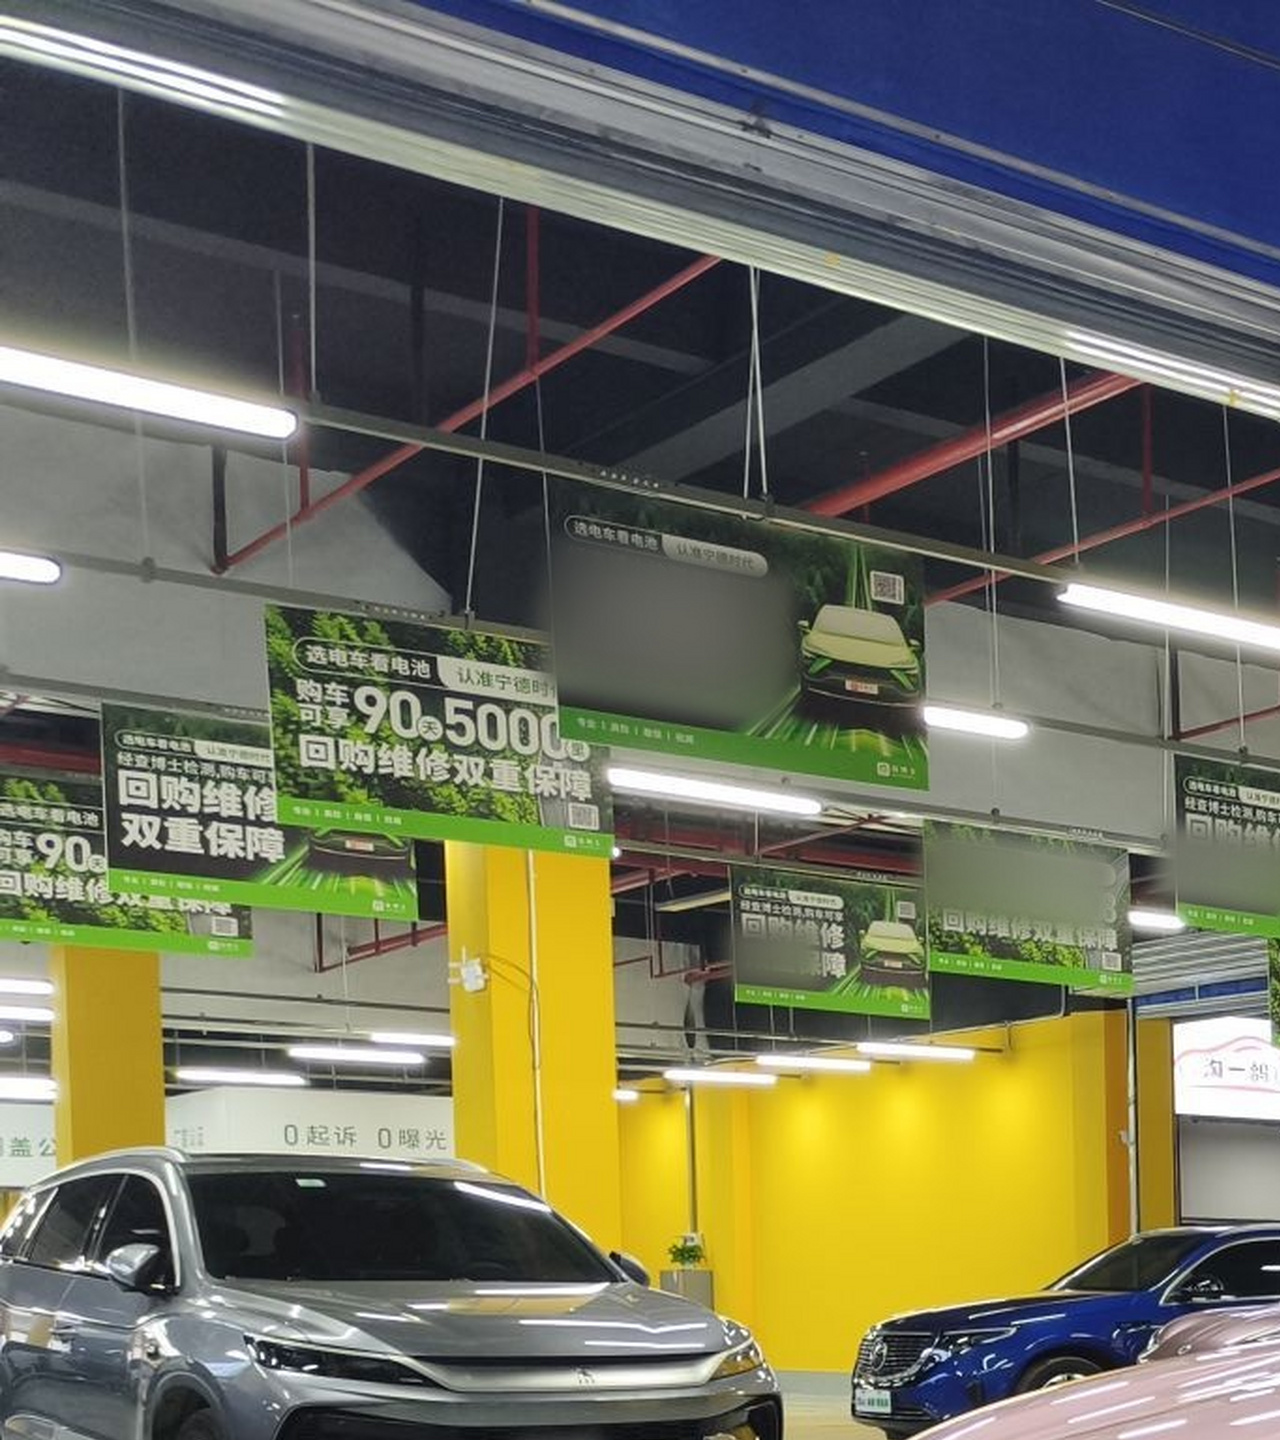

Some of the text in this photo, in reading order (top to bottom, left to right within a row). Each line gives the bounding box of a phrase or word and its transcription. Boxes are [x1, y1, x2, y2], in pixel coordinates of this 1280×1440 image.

[572, 519, 659, 551] 选电车看电池
[305, 643, 431, 680] 选电车看电池
[297, 679, 349, 704] 购车
[354, 685, 422, 739] 90
[298, 704, 349, 730] 可享
[299, 733, 593, 794] 回购维修双重保障
[117, 770, 277, 822] 回购维修
[35, 832, 92, 873] 90
[121, 812, 286, 864] 双重保障
